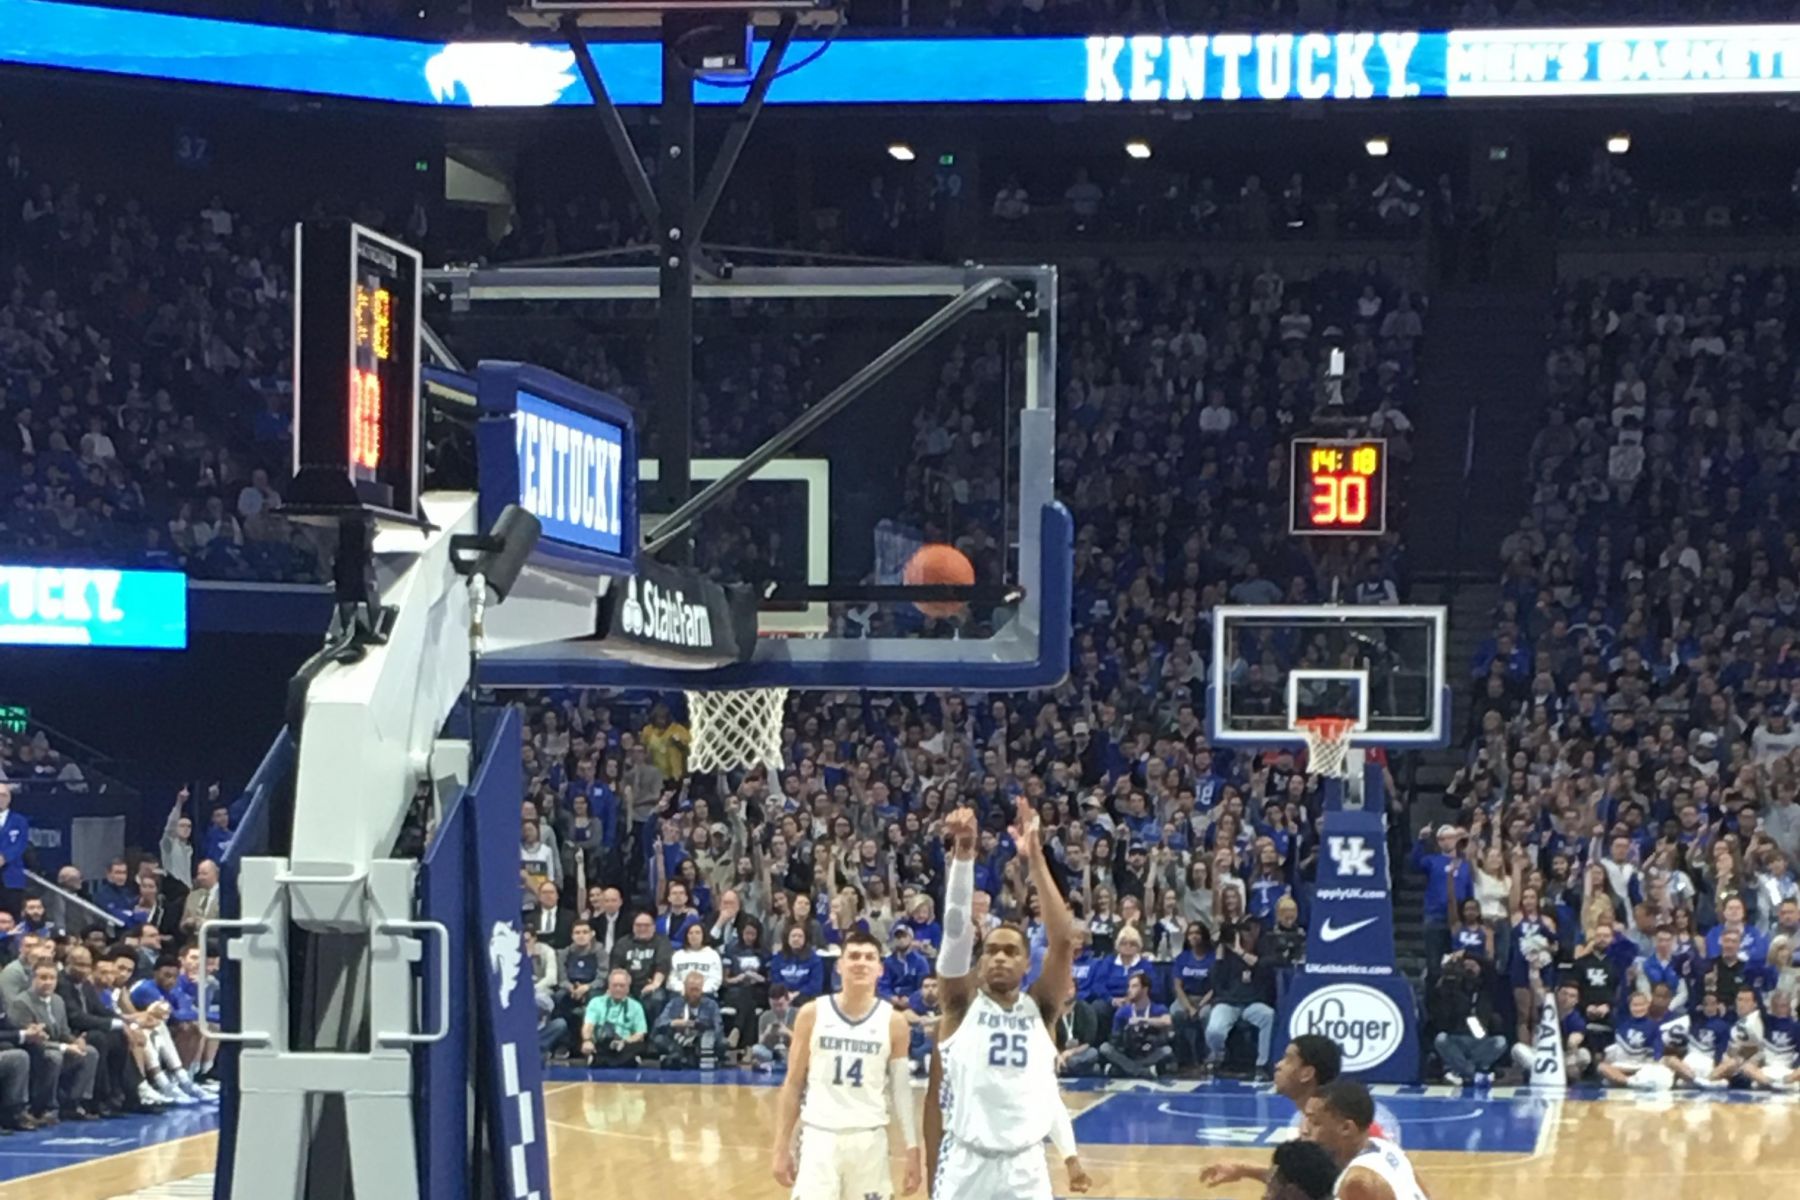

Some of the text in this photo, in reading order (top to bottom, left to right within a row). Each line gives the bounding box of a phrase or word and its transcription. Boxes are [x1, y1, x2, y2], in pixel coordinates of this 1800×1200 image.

[1085, 32, 1420, 101] KENTUCKY
[1311, 447, 1377, 475] 14:18
[1312, 475, 1367, 524] 30
[1328, 836, 1375, 876] UK
[819, 1035, 882, 1055] KENTUCKY
[1307, 998, 1391, 1059] Kroger
[1533, 1004, 1558, 1075] CATS
[988, 1032, 1028, 1069] 25
[832, 1056, 864, 1088] 14
